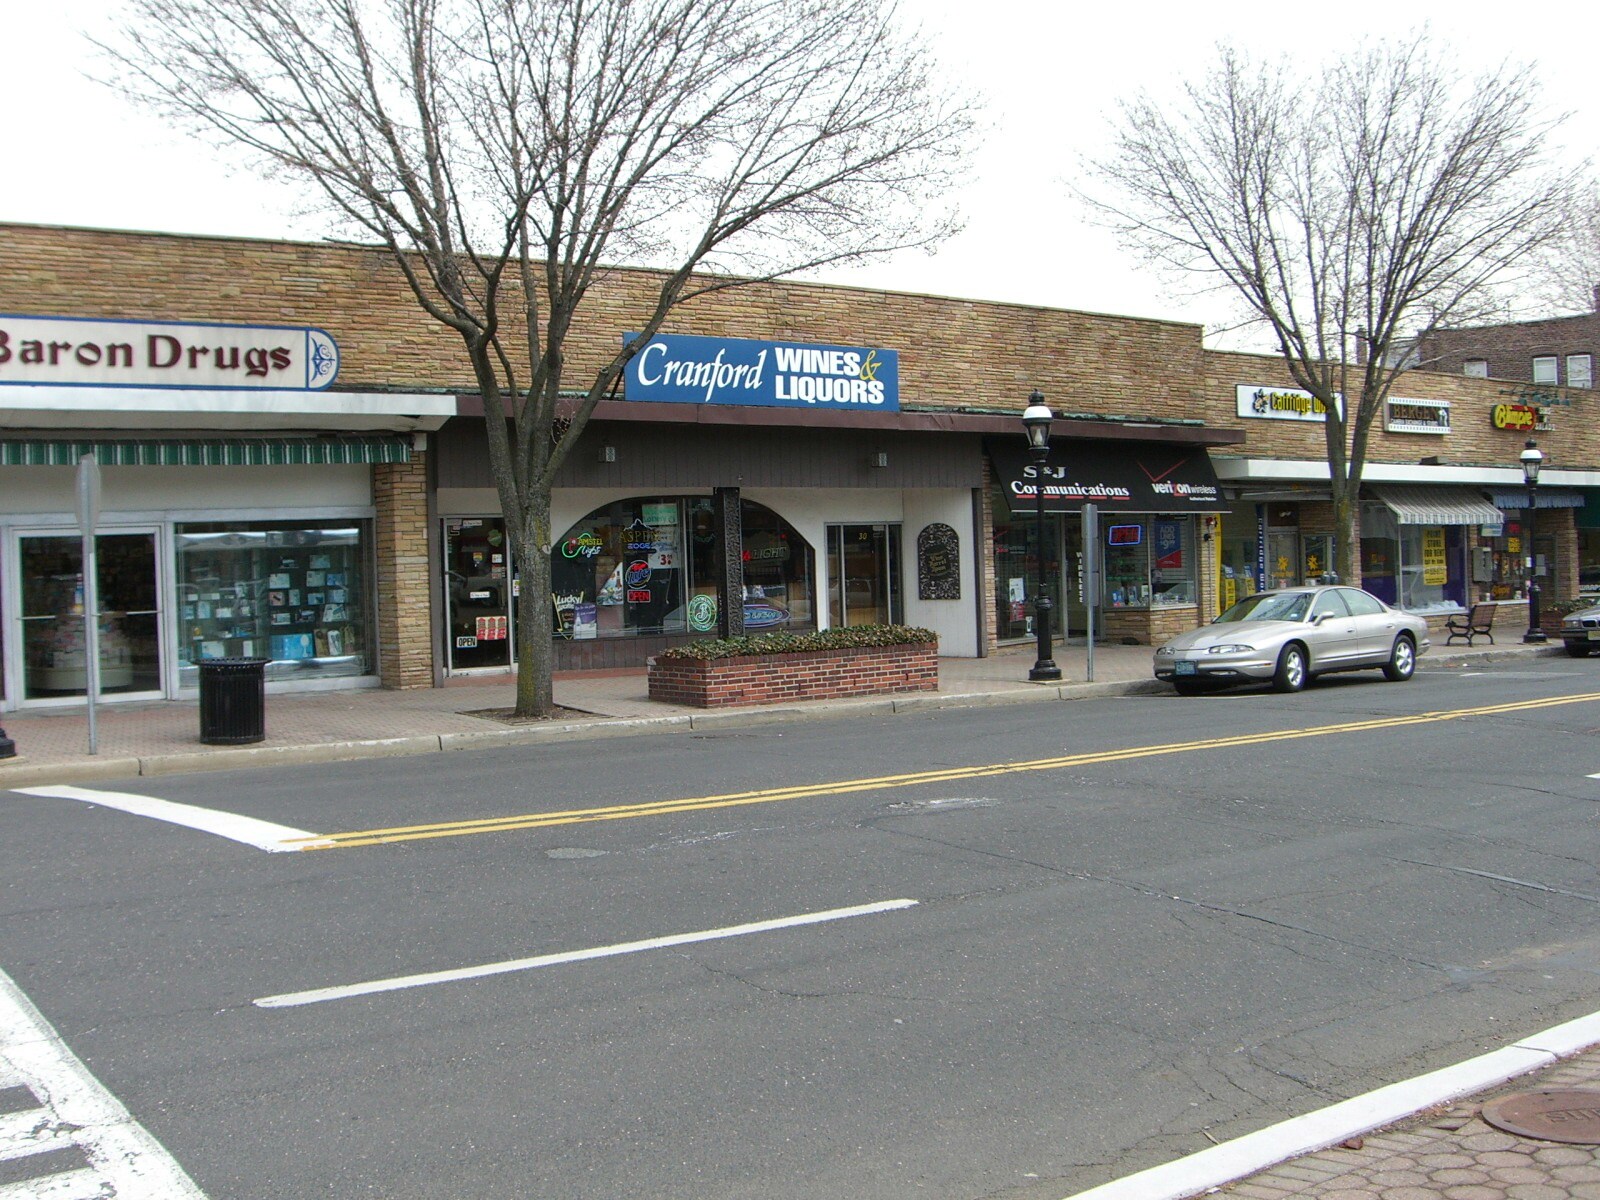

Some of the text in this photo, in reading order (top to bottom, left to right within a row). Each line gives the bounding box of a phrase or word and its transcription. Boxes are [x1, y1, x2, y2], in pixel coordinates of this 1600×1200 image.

[147, 334, 291, 377] Drugs
[637, 342, 882, 402] Cranford WINES &
[775, 375, 885, 405] LIQUORS
[1270, 392, 1311, 415] Cartridge
[1393, 404, 1439, 421] BERGEN
[1023, 465, 1067, 479] S & J
[1151, 480, 1217, 497] verizon wireless
[578, 538, 604, 546] AMSTEL
[858, 532, 868, 540] 30
[752, 546, 788, 560] LIGHT
[1076, 551, 1084, 603] WIRELESS
[557, 594, 580, 605] Lucky
[630, 591, 650, 601] OPEN
[459, 637, 475, 647] OPEN
